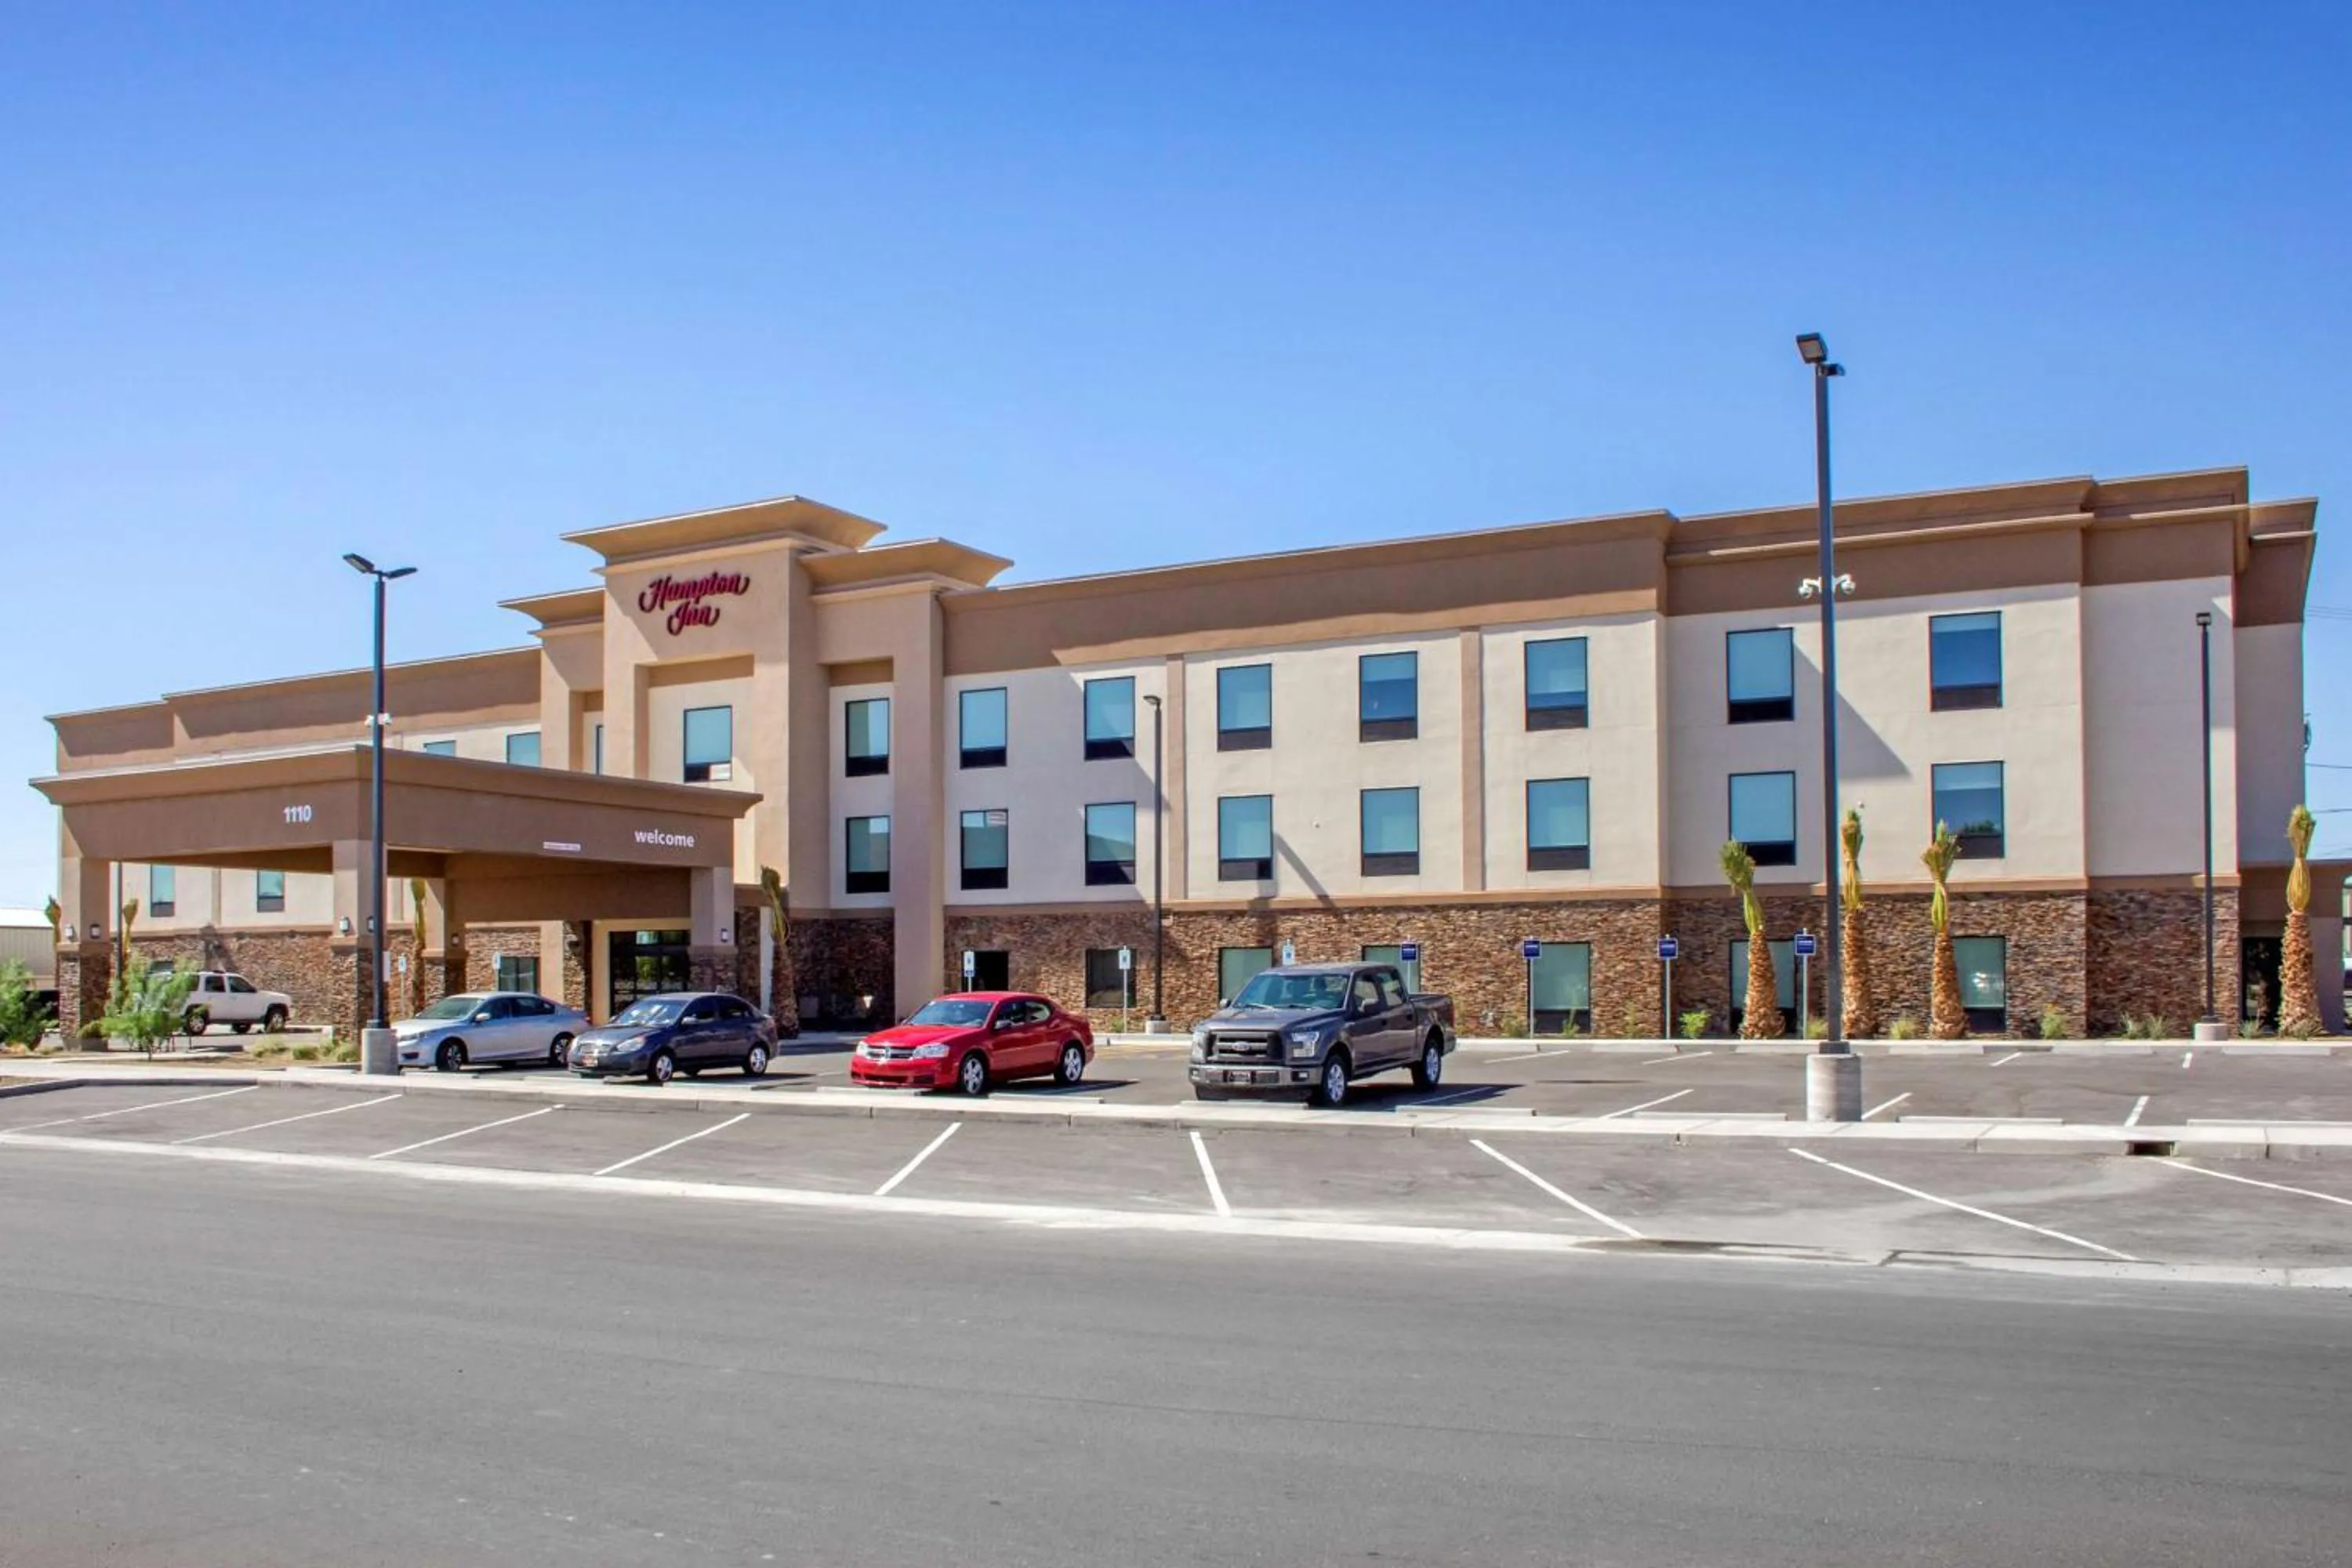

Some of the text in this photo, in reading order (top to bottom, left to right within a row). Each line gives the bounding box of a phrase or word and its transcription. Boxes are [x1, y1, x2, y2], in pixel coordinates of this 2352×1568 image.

[638, 571, 750, 612] Hampton
[667, 601, 720, 636] Inn
[282, 804, 312, 823] 1110
[633, 829, 695, 848] welcome
